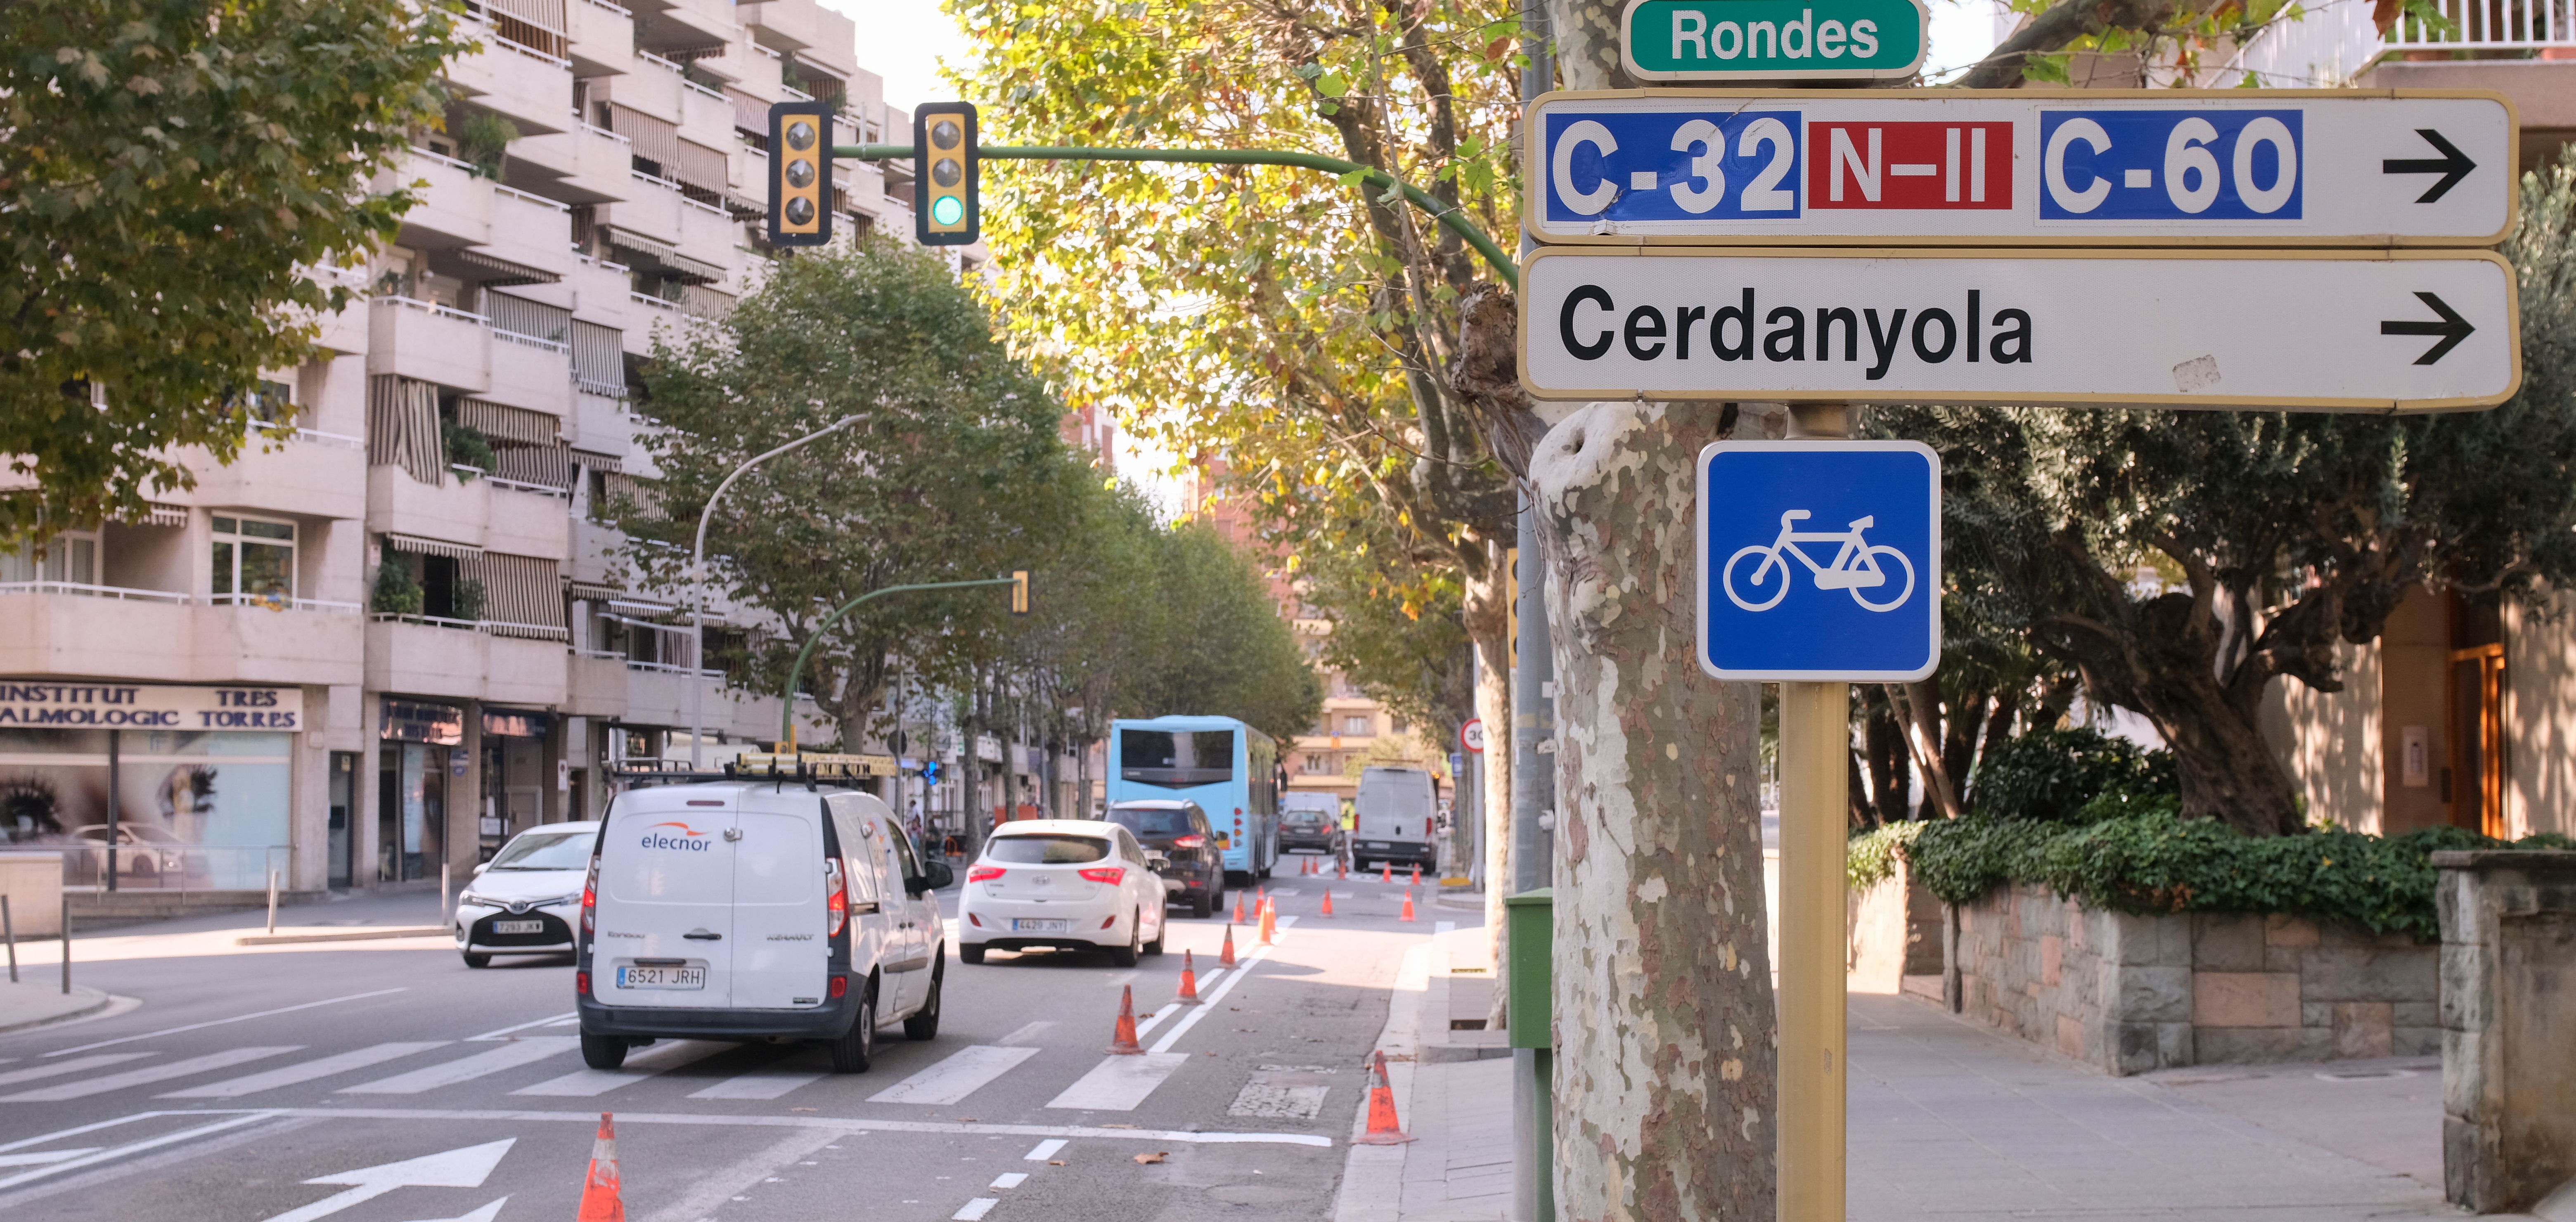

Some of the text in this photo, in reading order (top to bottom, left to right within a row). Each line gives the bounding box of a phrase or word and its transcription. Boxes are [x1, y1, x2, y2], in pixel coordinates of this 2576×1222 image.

[1672, 8, 1879, 60] Rondes
[1553, 117, 1794, 216] C-32
[2045, 116, 2297, 214] C-60
[1560, 284, 2033, 381] Cerdanyola
[0, 685, 277, 707] INSTITUT TRES
[198, 711, 295, 727] TORRES
[642, 832, 711, 851] elecnor
[628, 970, 700, 984] 6521 JRH
